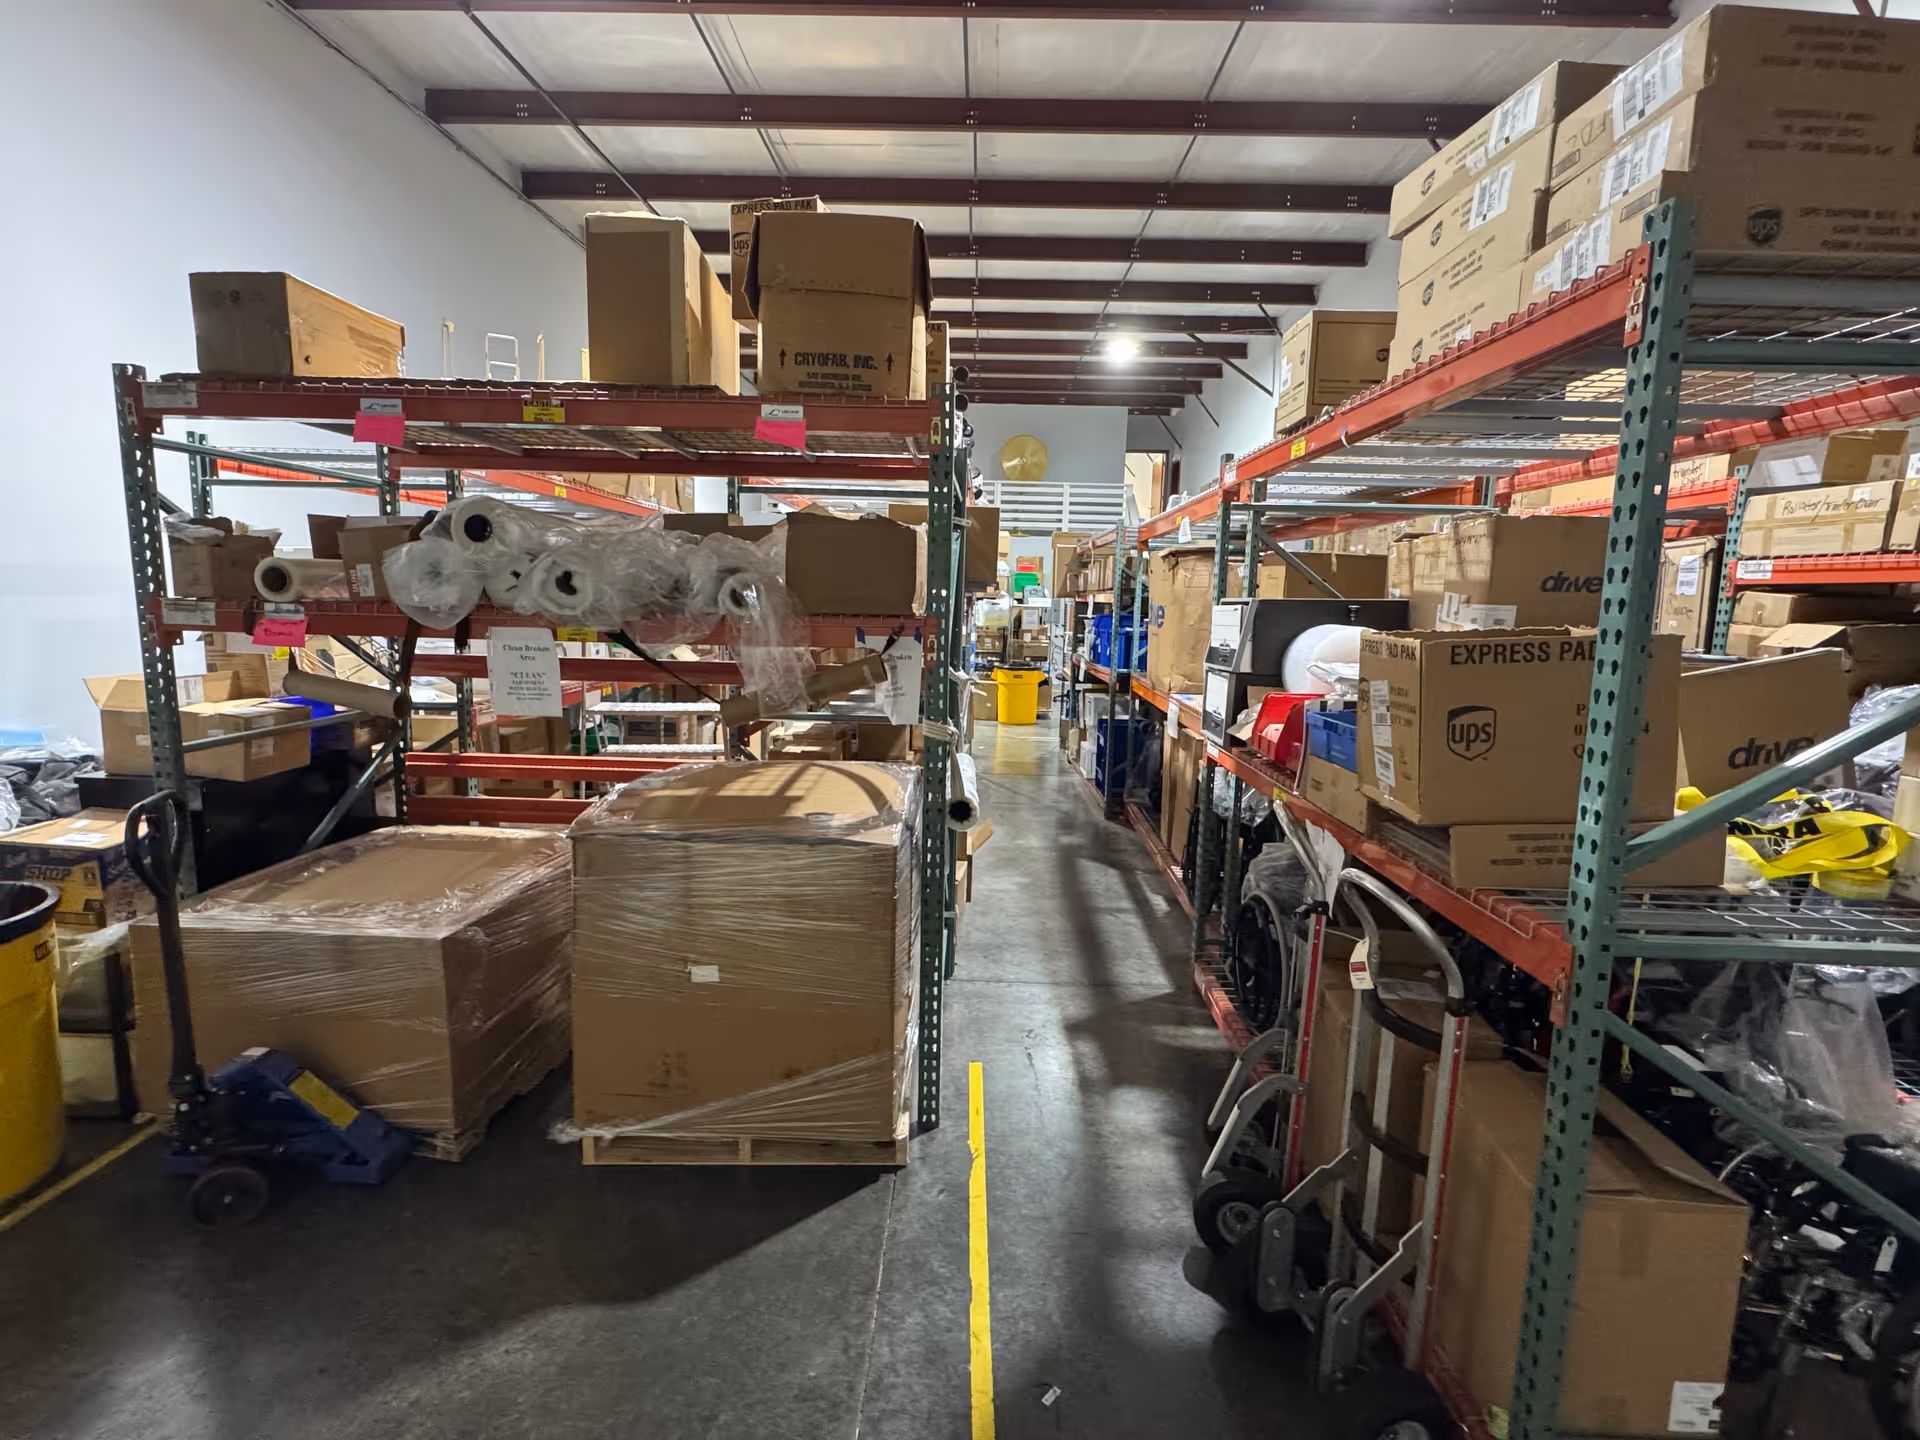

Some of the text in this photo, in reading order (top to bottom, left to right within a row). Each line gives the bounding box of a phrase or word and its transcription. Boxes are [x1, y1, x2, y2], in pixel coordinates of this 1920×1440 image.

[731, 199, 813, 215] EXPRESS PAD PAK
[1751, 218, 1778, 240] ups
[733, 239, 750, 251] ups
[794, 352, 878, 370] CRYOFAB, INC.
[1541, 570, 1604, 593] drive
[1400, 644, 1417, 660] PAK
[1450, 643, 1550, 665] EXPRESS
[1451, 723, 1493, 751] ups
[25, 866, 71, 880] SHOP
